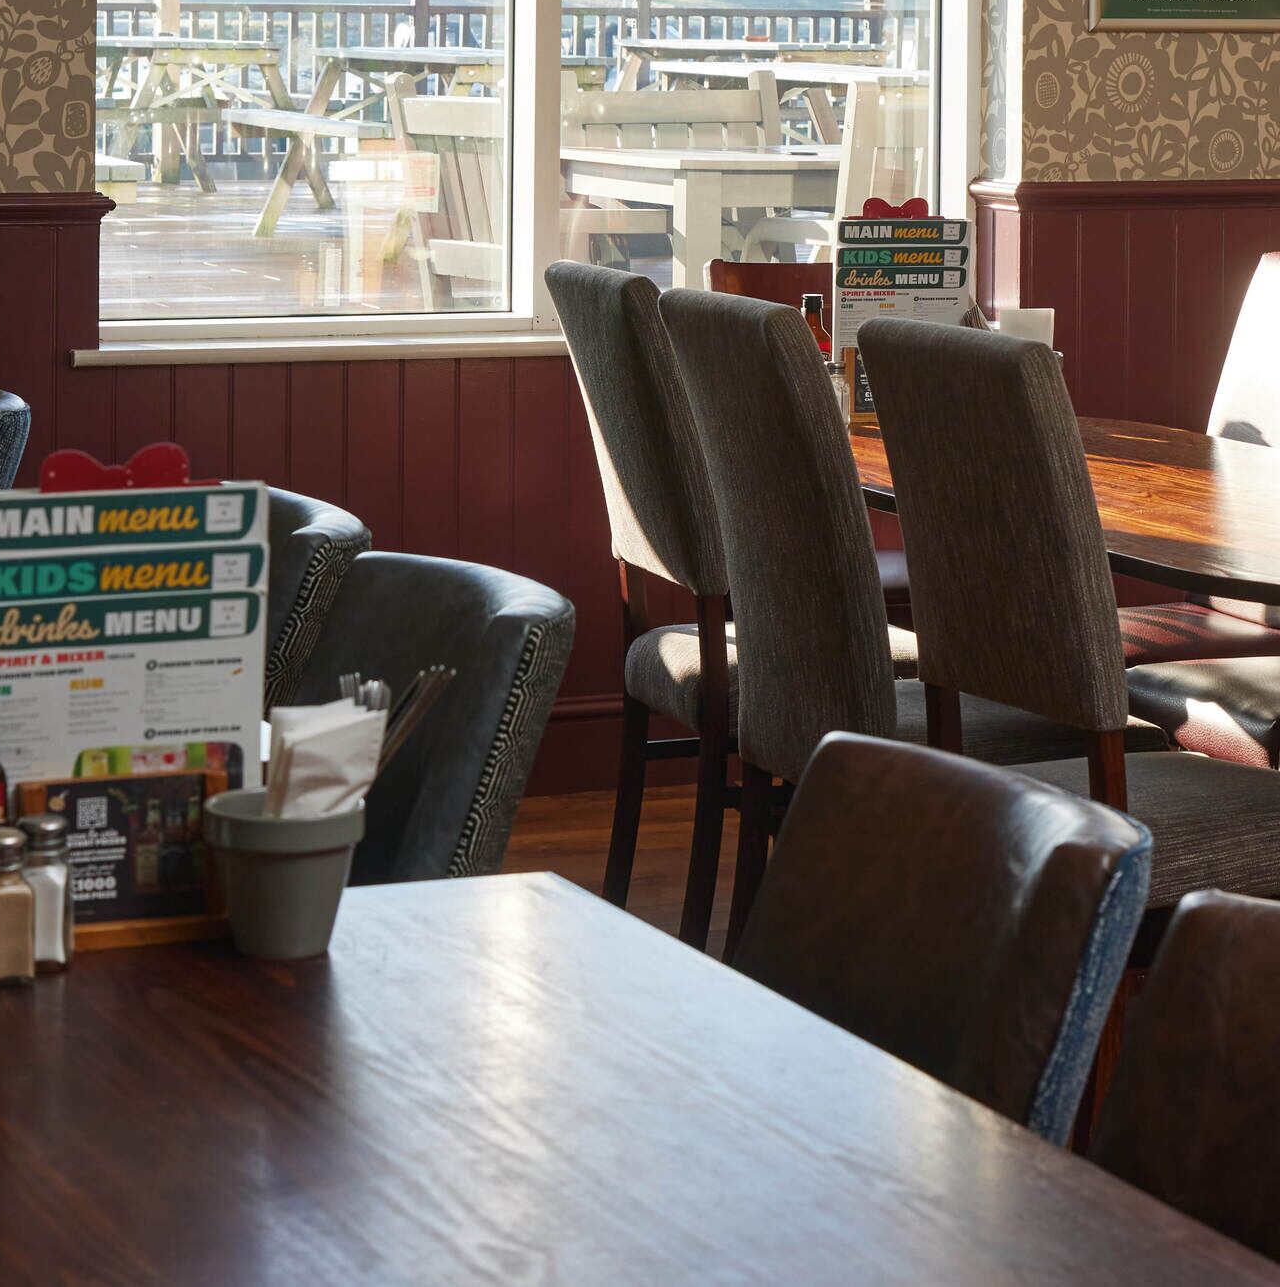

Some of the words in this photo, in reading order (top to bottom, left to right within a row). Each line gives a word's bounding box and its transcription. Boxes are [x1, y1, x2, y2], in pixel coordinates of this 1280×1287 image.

[844, 225, 892, 239] MAIN
[894, 226, 940, 239] menu
[843, 249, 892, 265] KIDS
[892, 250, 943, 264] menu
[844, 268, 893, 286] drinks
[895, 273, 940, 285] MENU
[97, 504, 200, 535] menu
[99, 559, 210, 592] menu
[103, 606, 203, 638] MENU
[41, 654, 51, 665] &
[56, 650, 105, 663] MIXER
